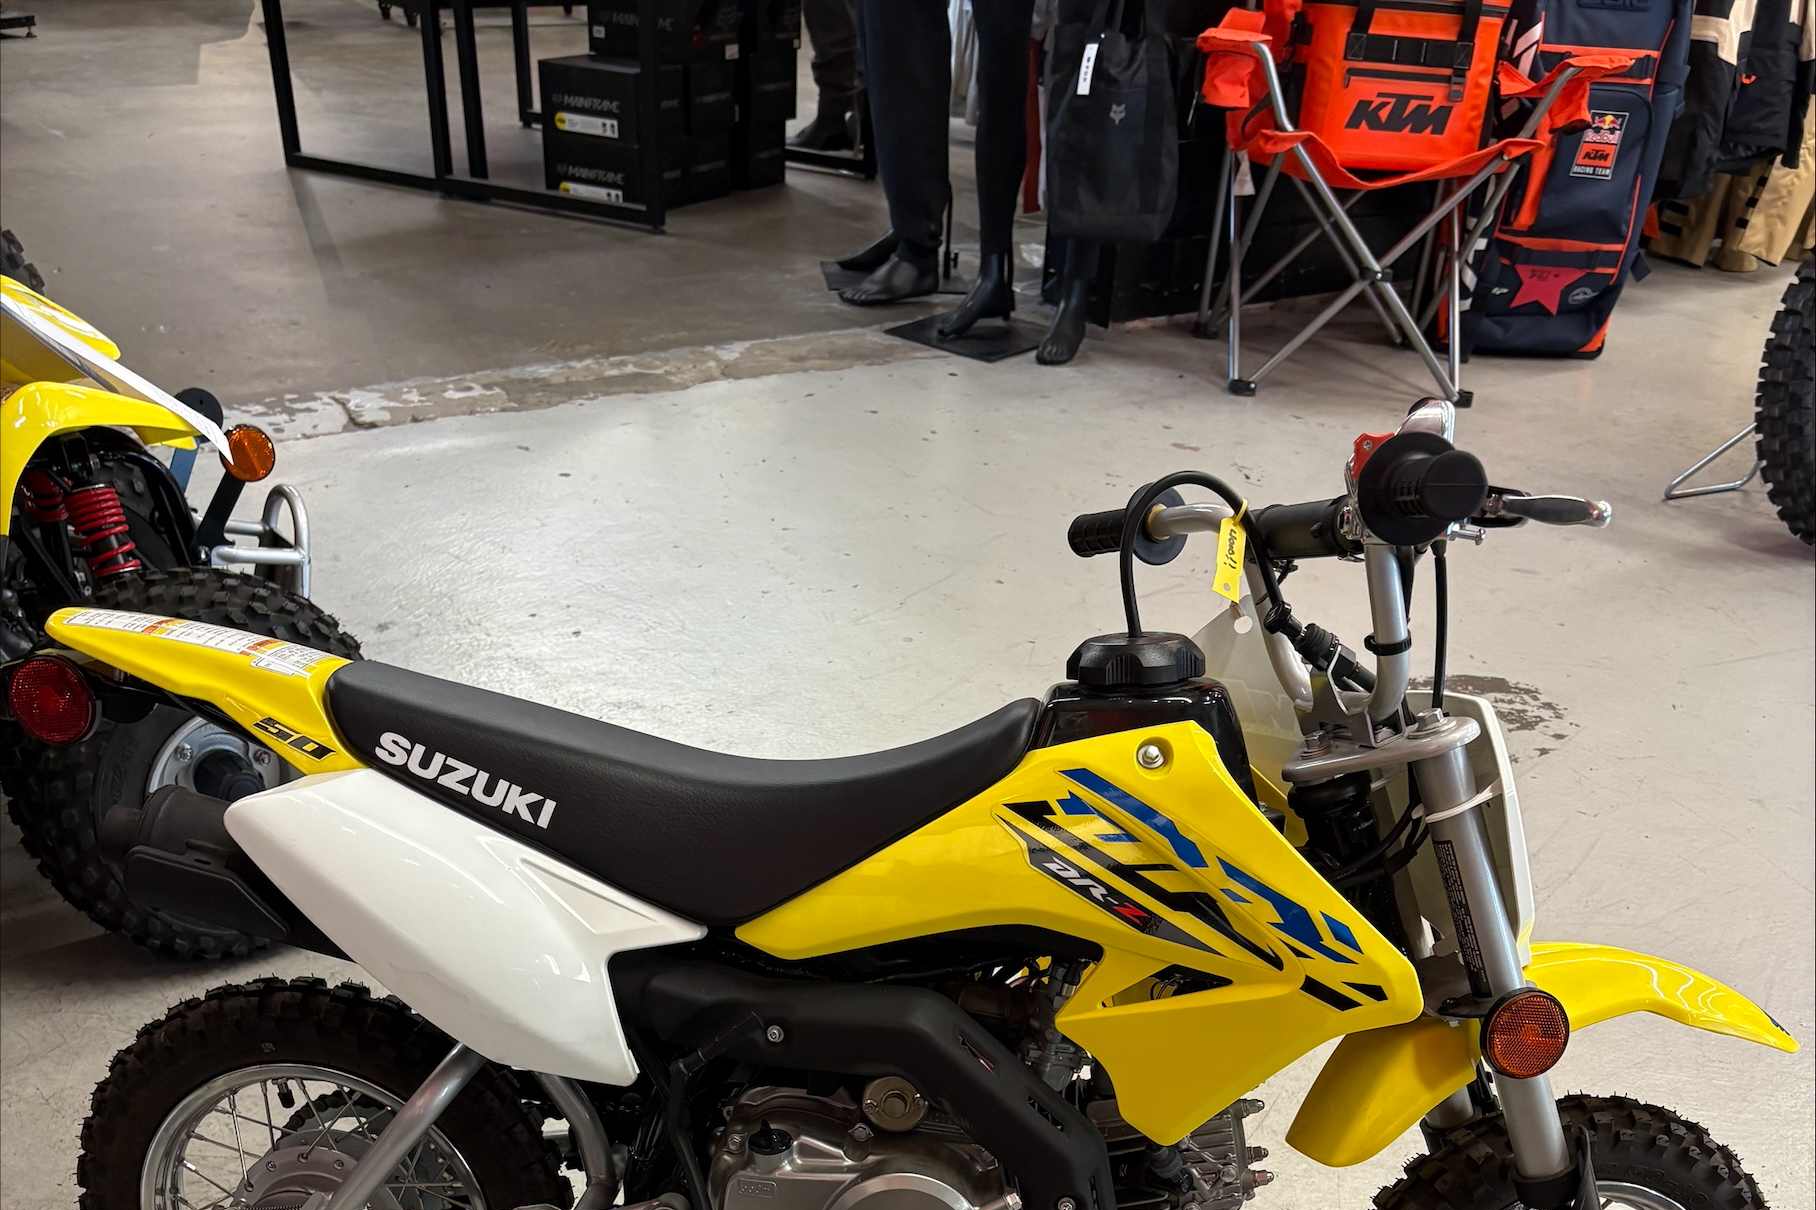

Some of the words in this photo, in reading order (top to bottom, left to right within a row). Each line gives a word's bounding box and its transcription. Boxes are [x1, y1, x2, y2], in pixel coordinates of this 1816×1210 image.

[1344, 92, 1454, 135] KTM
[1582, 149, 1610, 162] KTM
[1595, 168, 1611, 176] TEAM
[252, 717, 338, 760] 50
[375, 731, 557, 829] SUZUKI
[1041, 856, 1151, 926] DR-Z
